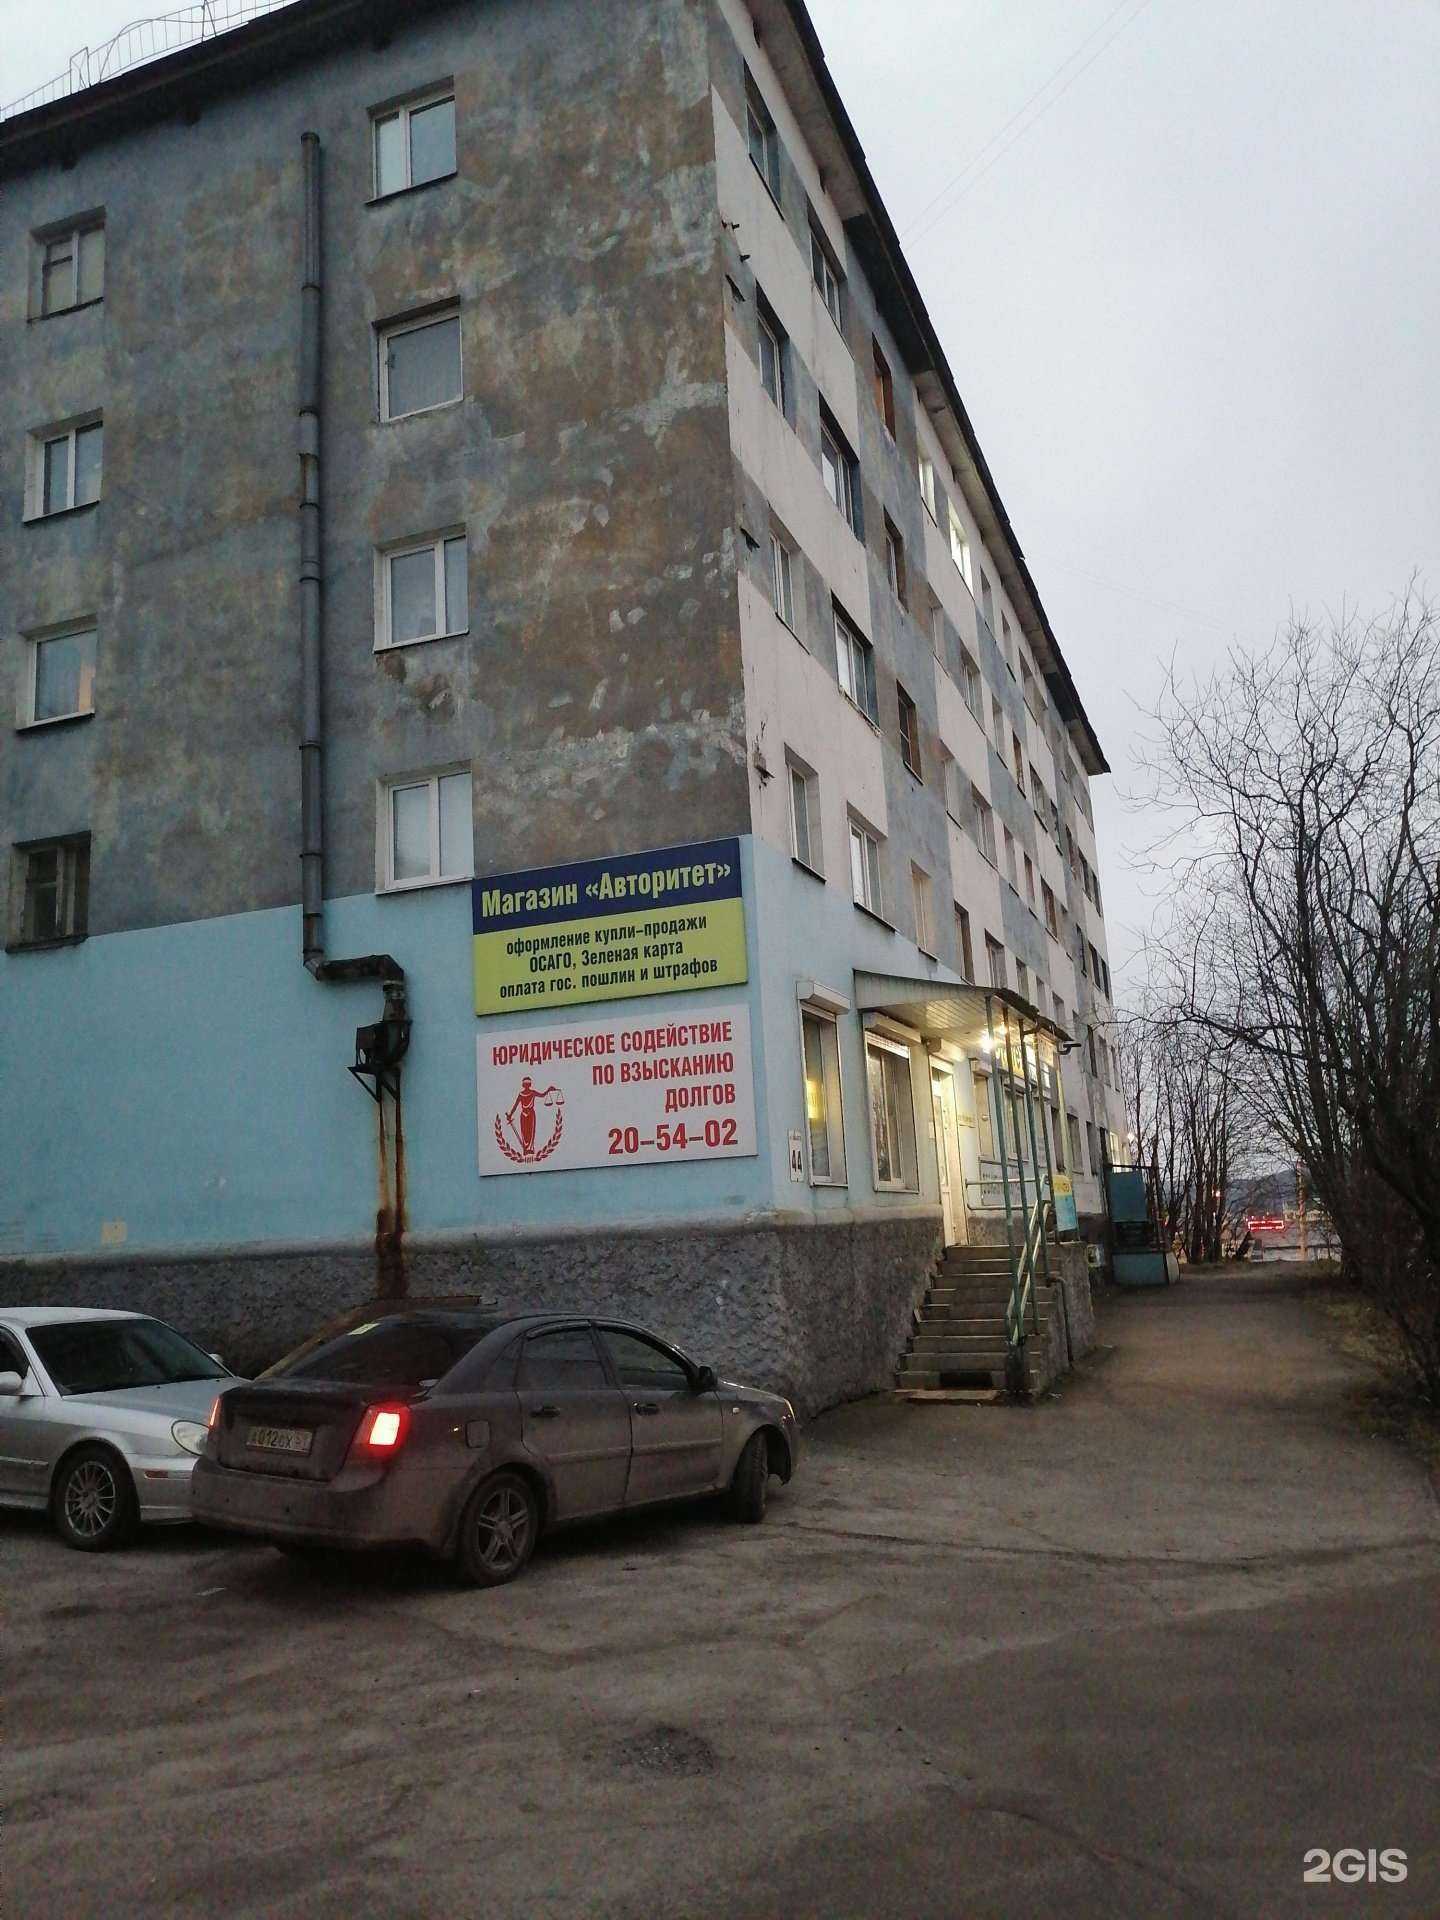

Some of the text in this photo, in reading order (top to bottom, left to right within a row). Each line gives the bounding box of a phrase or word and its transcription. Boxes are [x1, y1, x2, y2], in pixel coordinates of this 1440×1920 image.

[482, 862, 731, 917] Магазин «Авторитет»
[507, 931, 590, 956] оформление
[530, 940, 683, 973] ОСАГО, Зеленая карта
[500, 958, 718, 998] оплата гос. пошлин и штрафов
[493, 1021, 732, 1066] ЮРИДИЧЕСКОЕ СОДЕЙСТВИЕ
[592, 1052, 734, 1085] ПО ВЗЫСКАНИЮ
[665, 1083, 736, 1113] ДОЛГОВ
[608, 1118, 738, 1155] 20-54-02
